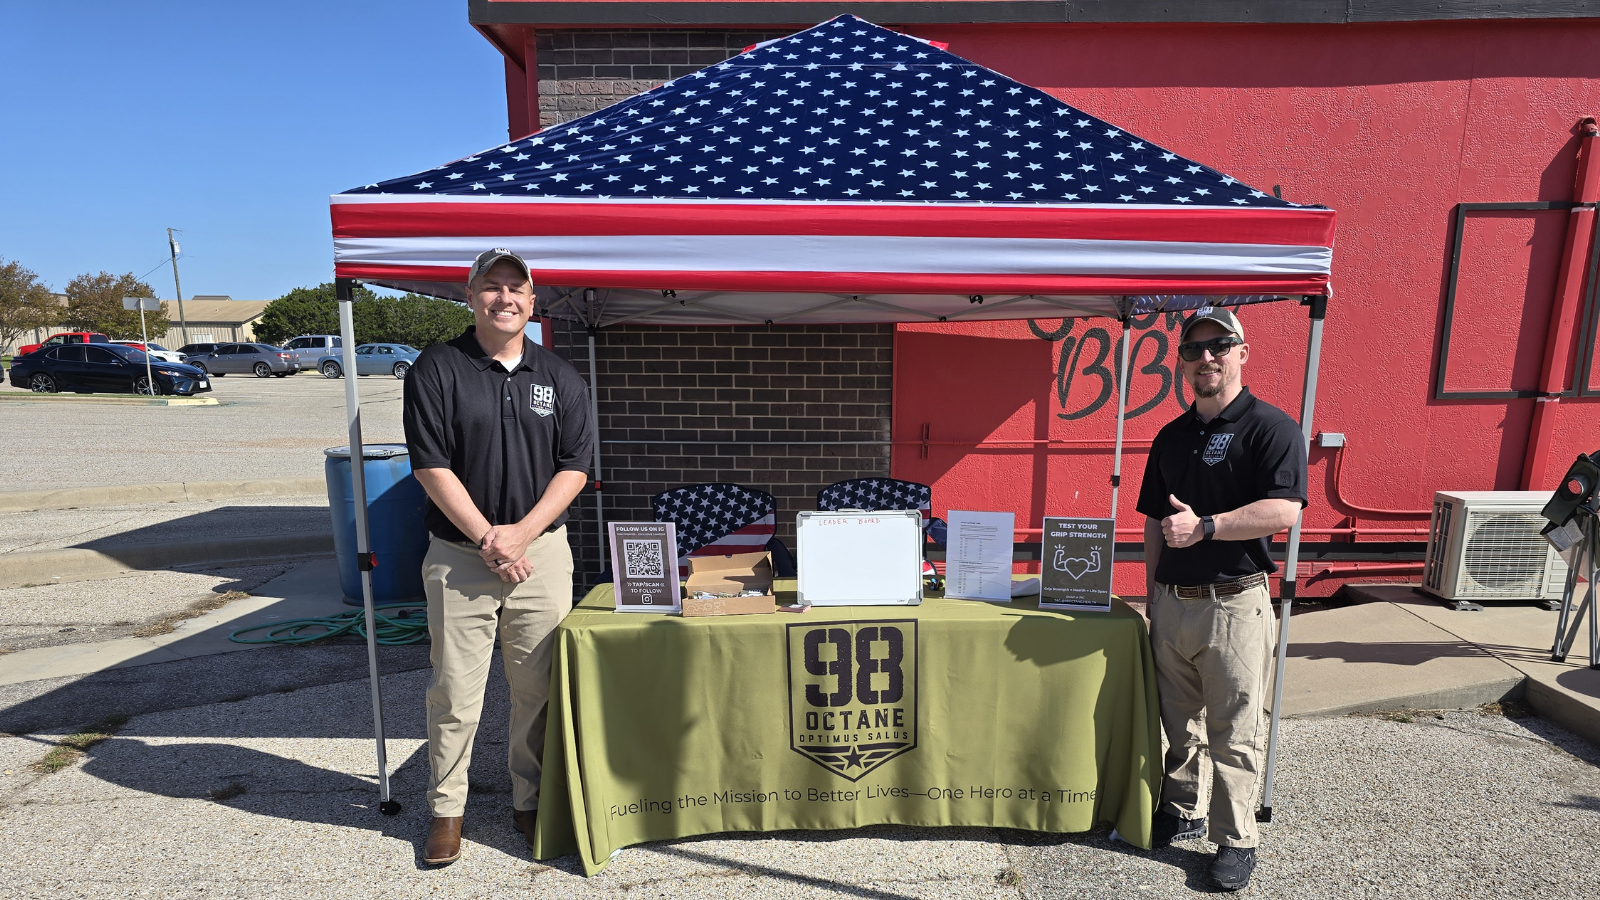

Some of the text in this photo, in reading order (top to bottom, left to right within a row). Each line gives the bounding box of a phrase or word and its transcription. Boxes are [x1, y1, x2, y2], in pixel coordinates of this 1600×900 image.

[533, 386, 554, 404] 98
[1208, 434, 1230, 450] 98
[818, 517, 881, 527] LEADER BOARD
[803, 626, 904, 707] 98
[805, 708, 904, 731] OCTANE
[799, 731, 908, 743] OPTIMUS SALUS
[610, 799, 672, 821] Fueling
[677, 794, 708, 809] the
[713, 789, 779, 805] Mission
[784, 788, 802, 801] to
[807, 787, 861, 802] Better
[970, 785, 1013, 799] Hero
[1018, 787, 1036, 800] at
[1041, 791, 1051, 802] a
[1056, 788, 1099, 804] Time
